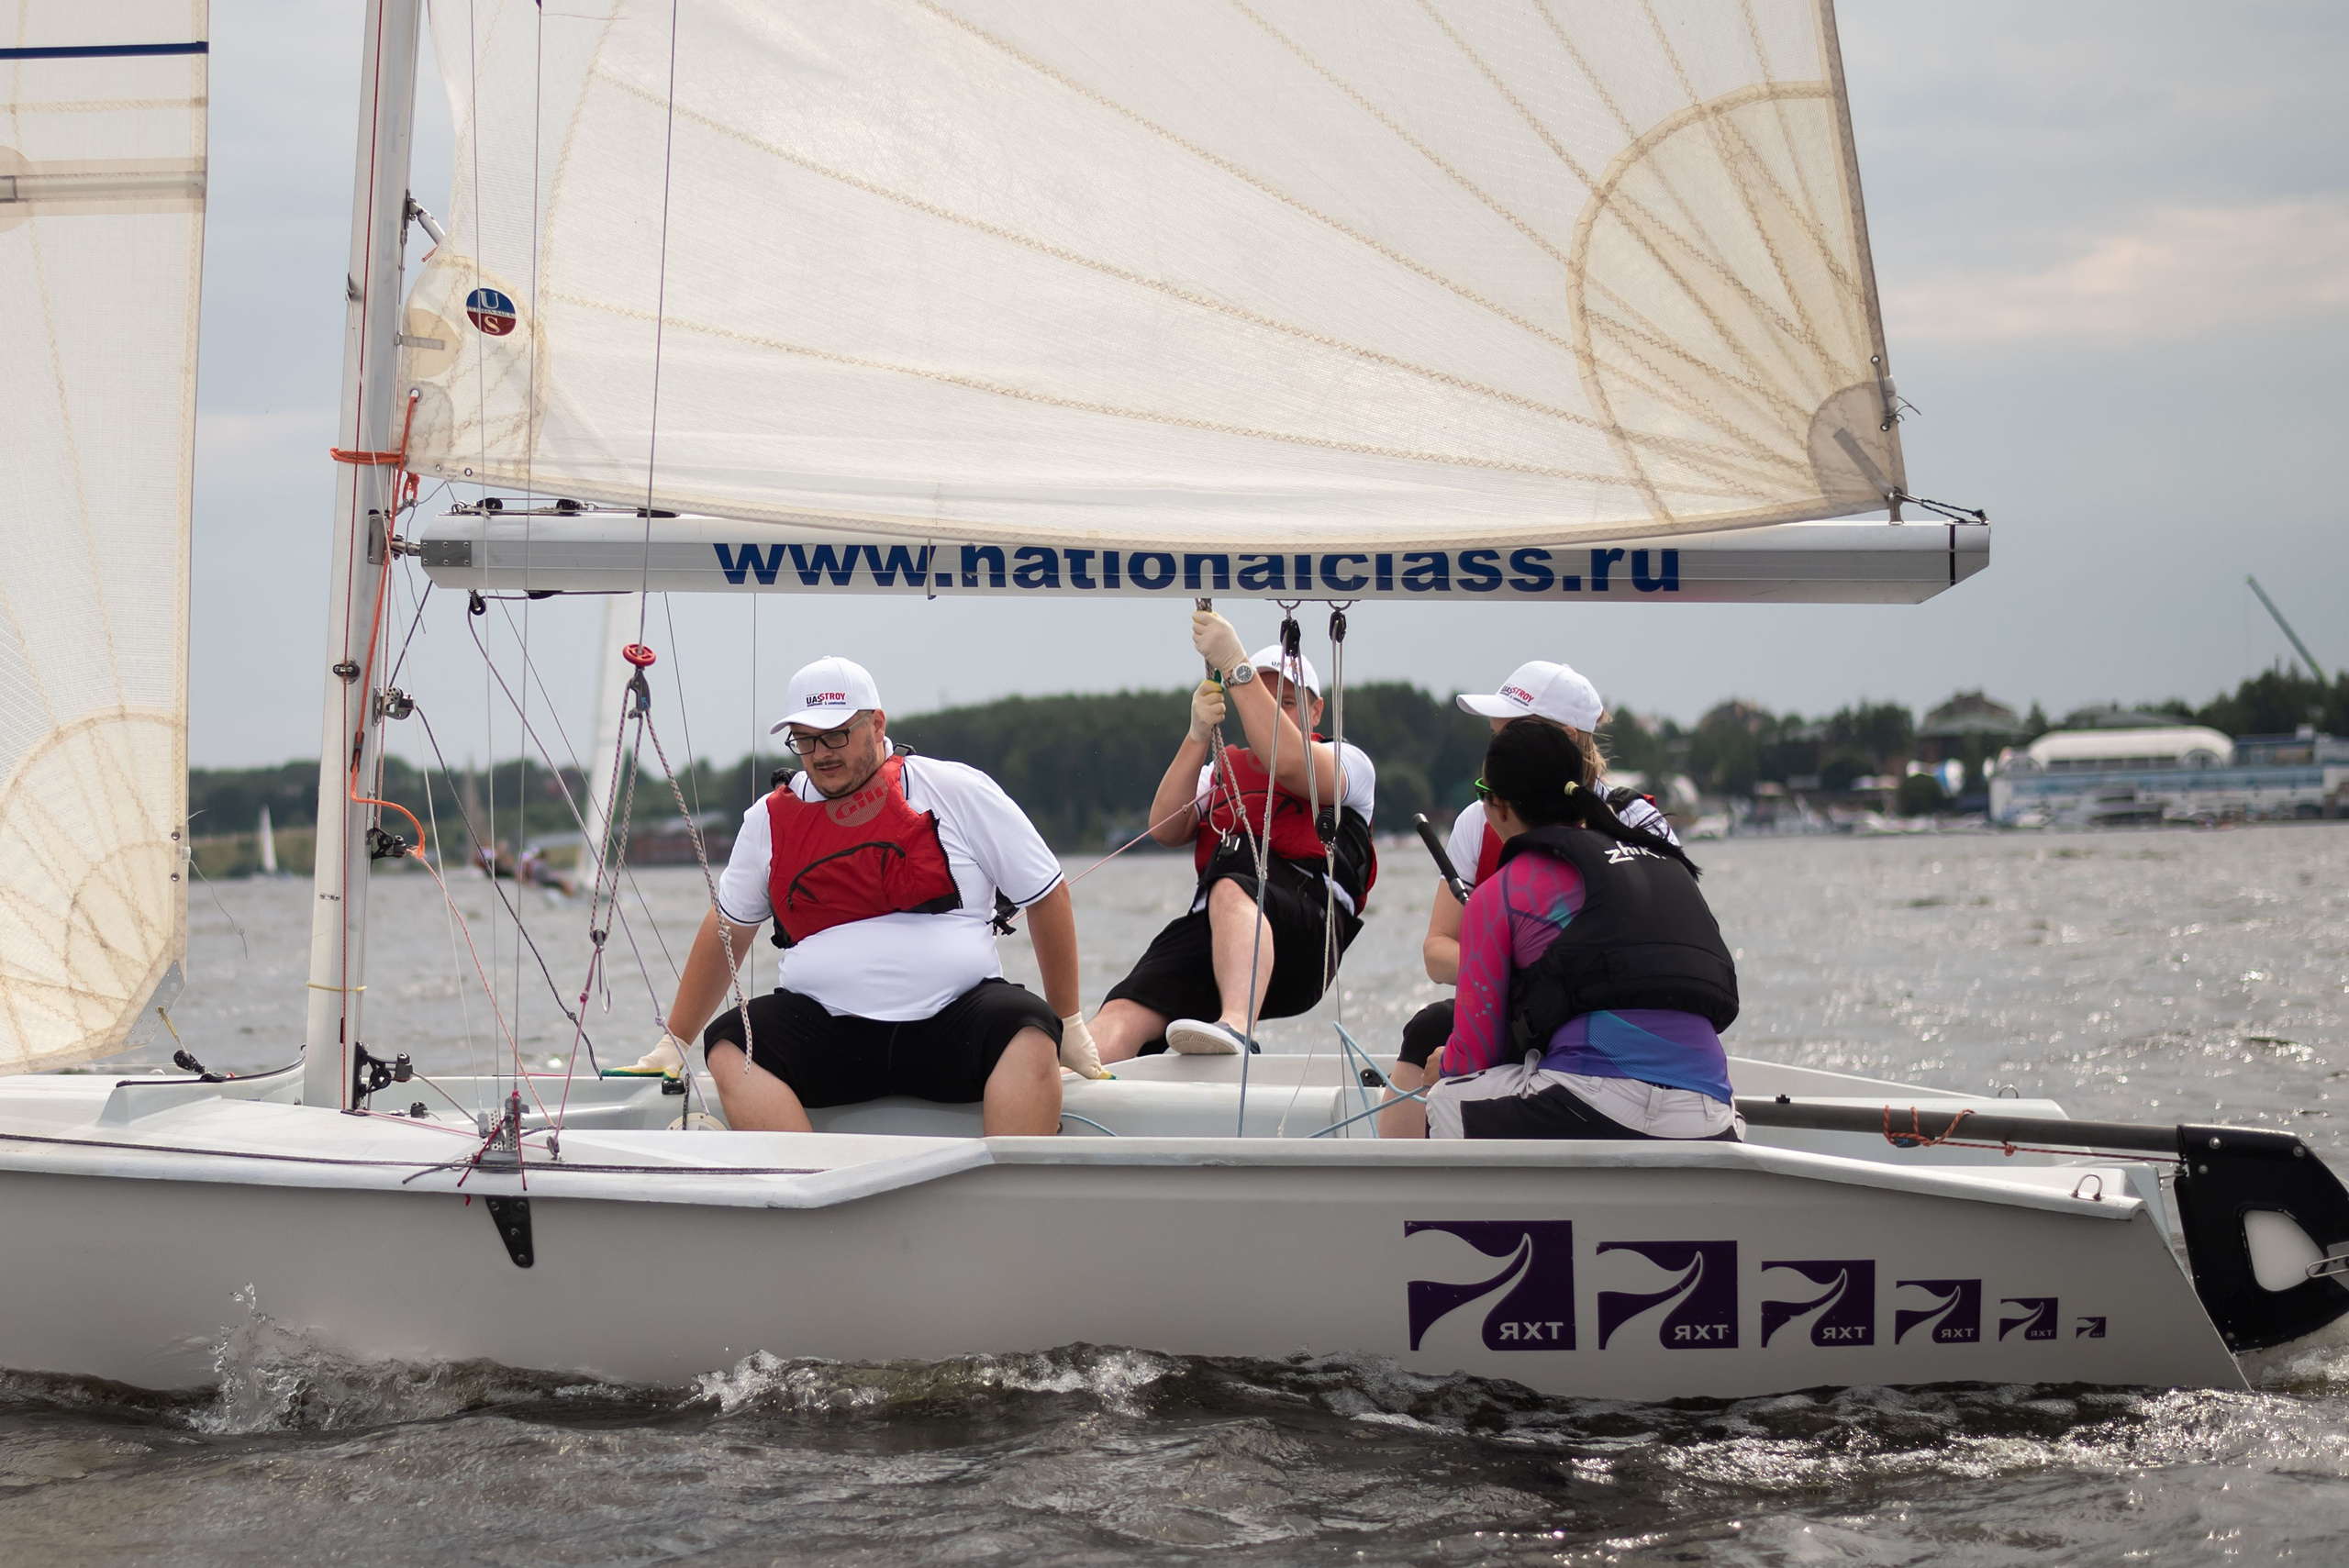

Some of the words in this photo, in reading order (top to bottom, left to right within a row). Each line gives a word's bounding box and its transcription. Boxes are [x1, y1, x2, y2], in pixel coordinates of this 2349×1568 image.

[480, 290, 499, 309] U
[484, 316, 501, 334] S
[712, 542, 1680, 592] www.nationalclass.ru
[835, 786, 884, 820] Gill
